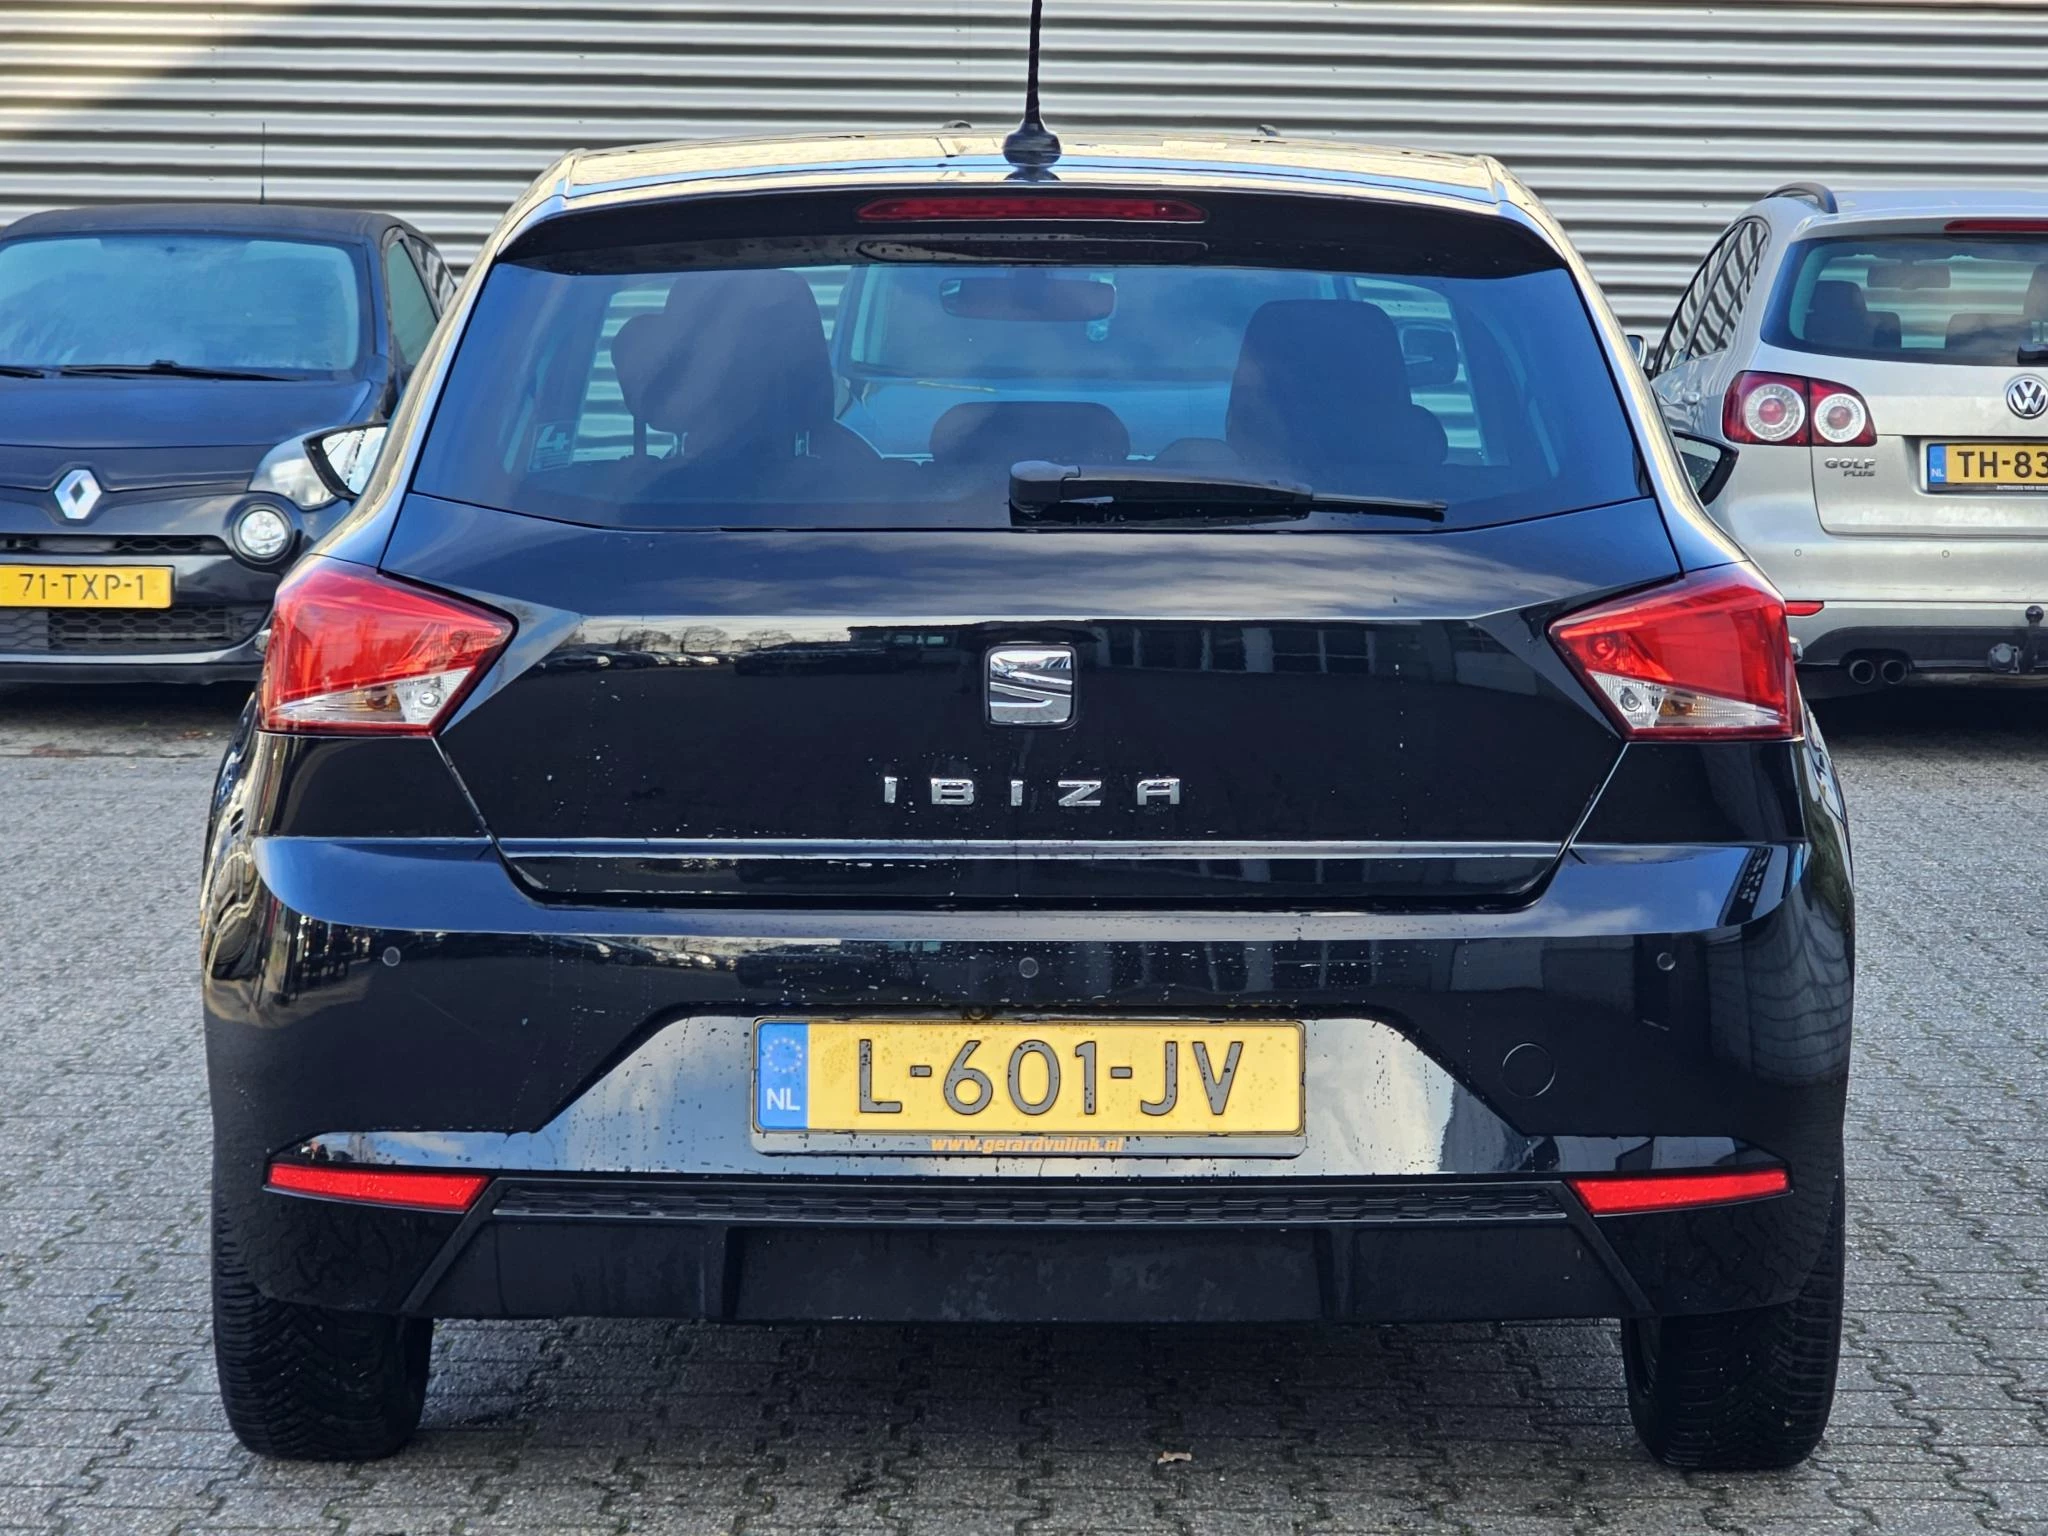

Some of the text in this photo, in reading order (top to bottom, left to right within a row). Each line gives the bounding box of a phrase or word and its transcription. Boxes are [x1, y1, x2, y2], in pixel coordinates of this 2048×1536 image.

[1824, 457, 1876, 469] GOLF
[1931, 468, 1944, 477] NL
[1957, 451, 2048, 478] TH-83
[19, 573, 144, 600] 71-TXP-1
[884, 776, 1180, 806] IBIZA
[859, 1038, 1244, 1116] L-601-JV
[766, 1087, 801, 1111] NL
